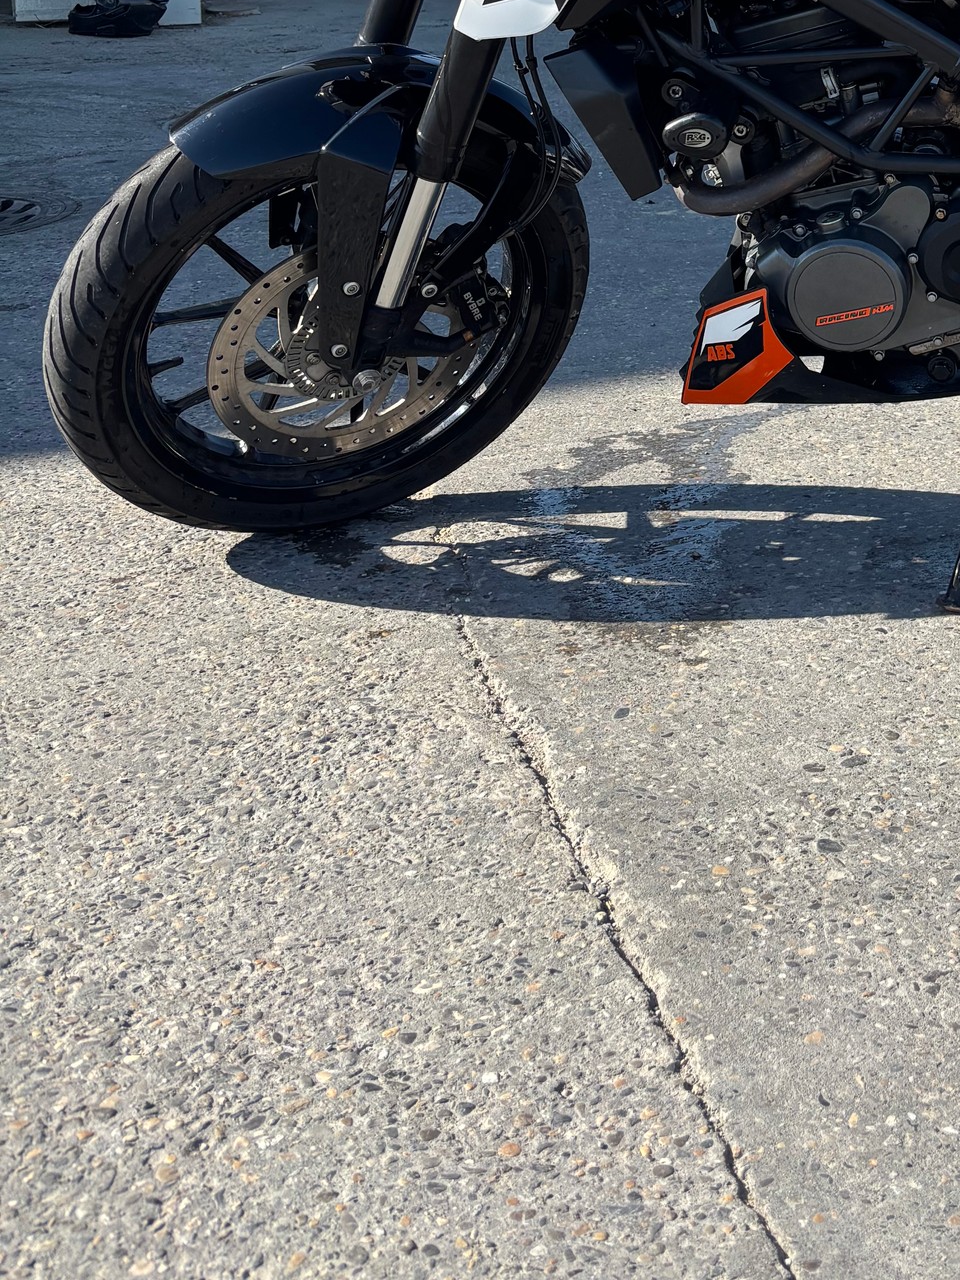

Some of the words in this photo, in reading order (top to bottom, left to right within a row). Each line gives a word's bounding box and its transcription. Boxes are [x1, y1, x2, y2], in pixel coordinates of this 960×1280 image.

[686, 133, 706, 141] R&G
[463, 291, 483, 321] BYBRE
[818, 310, 868, 324] RACING
[871, 304, 894, 315] KTM
[706, 343, 735, 363] ABS
